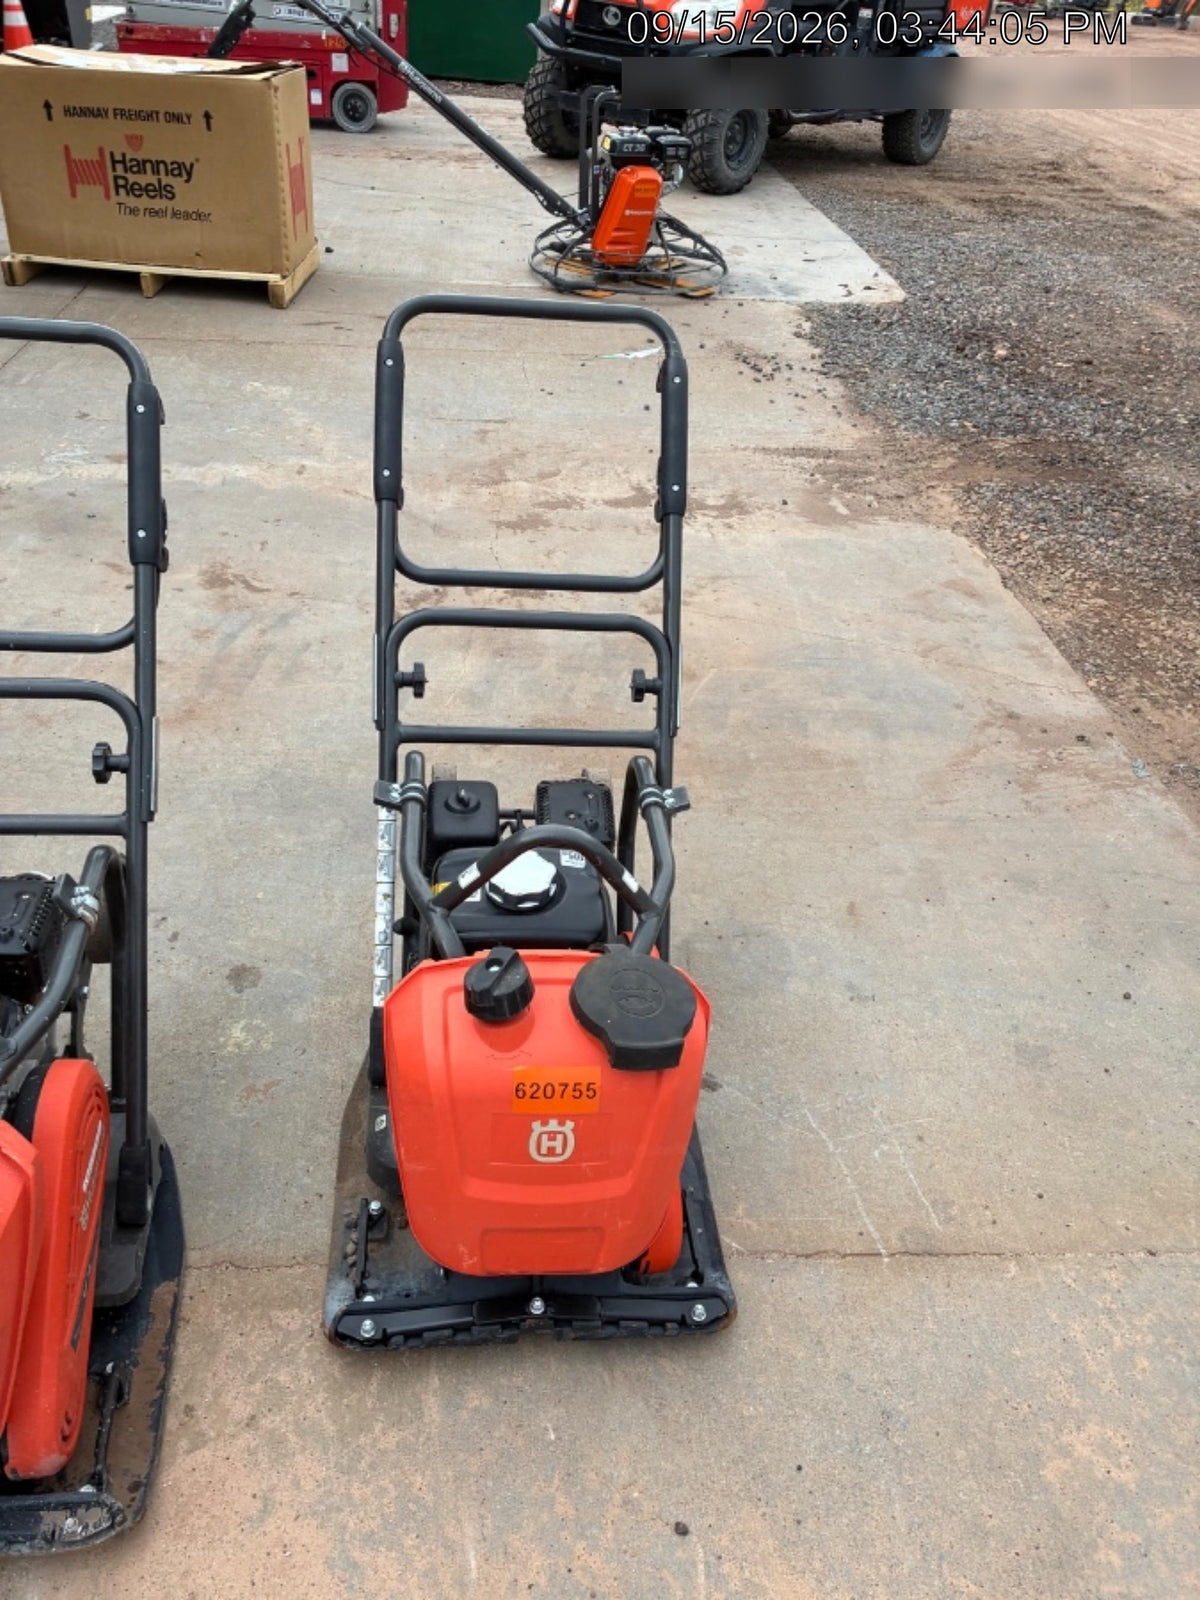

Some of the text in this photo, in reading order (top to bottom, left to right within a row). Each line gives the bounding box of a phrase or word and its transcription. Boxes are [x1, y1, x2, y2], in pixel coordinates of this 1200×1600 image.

[63, 105, 192, 125] HANNAY FREIGHT ONLY
[109, 151, 195, 183] Hannay
[113, 175, 176, 200] Reels
[116, 203, 140, 217] The
[143, 206, 168, 218] reel
[514, 1081, 598, 1100] 620755
